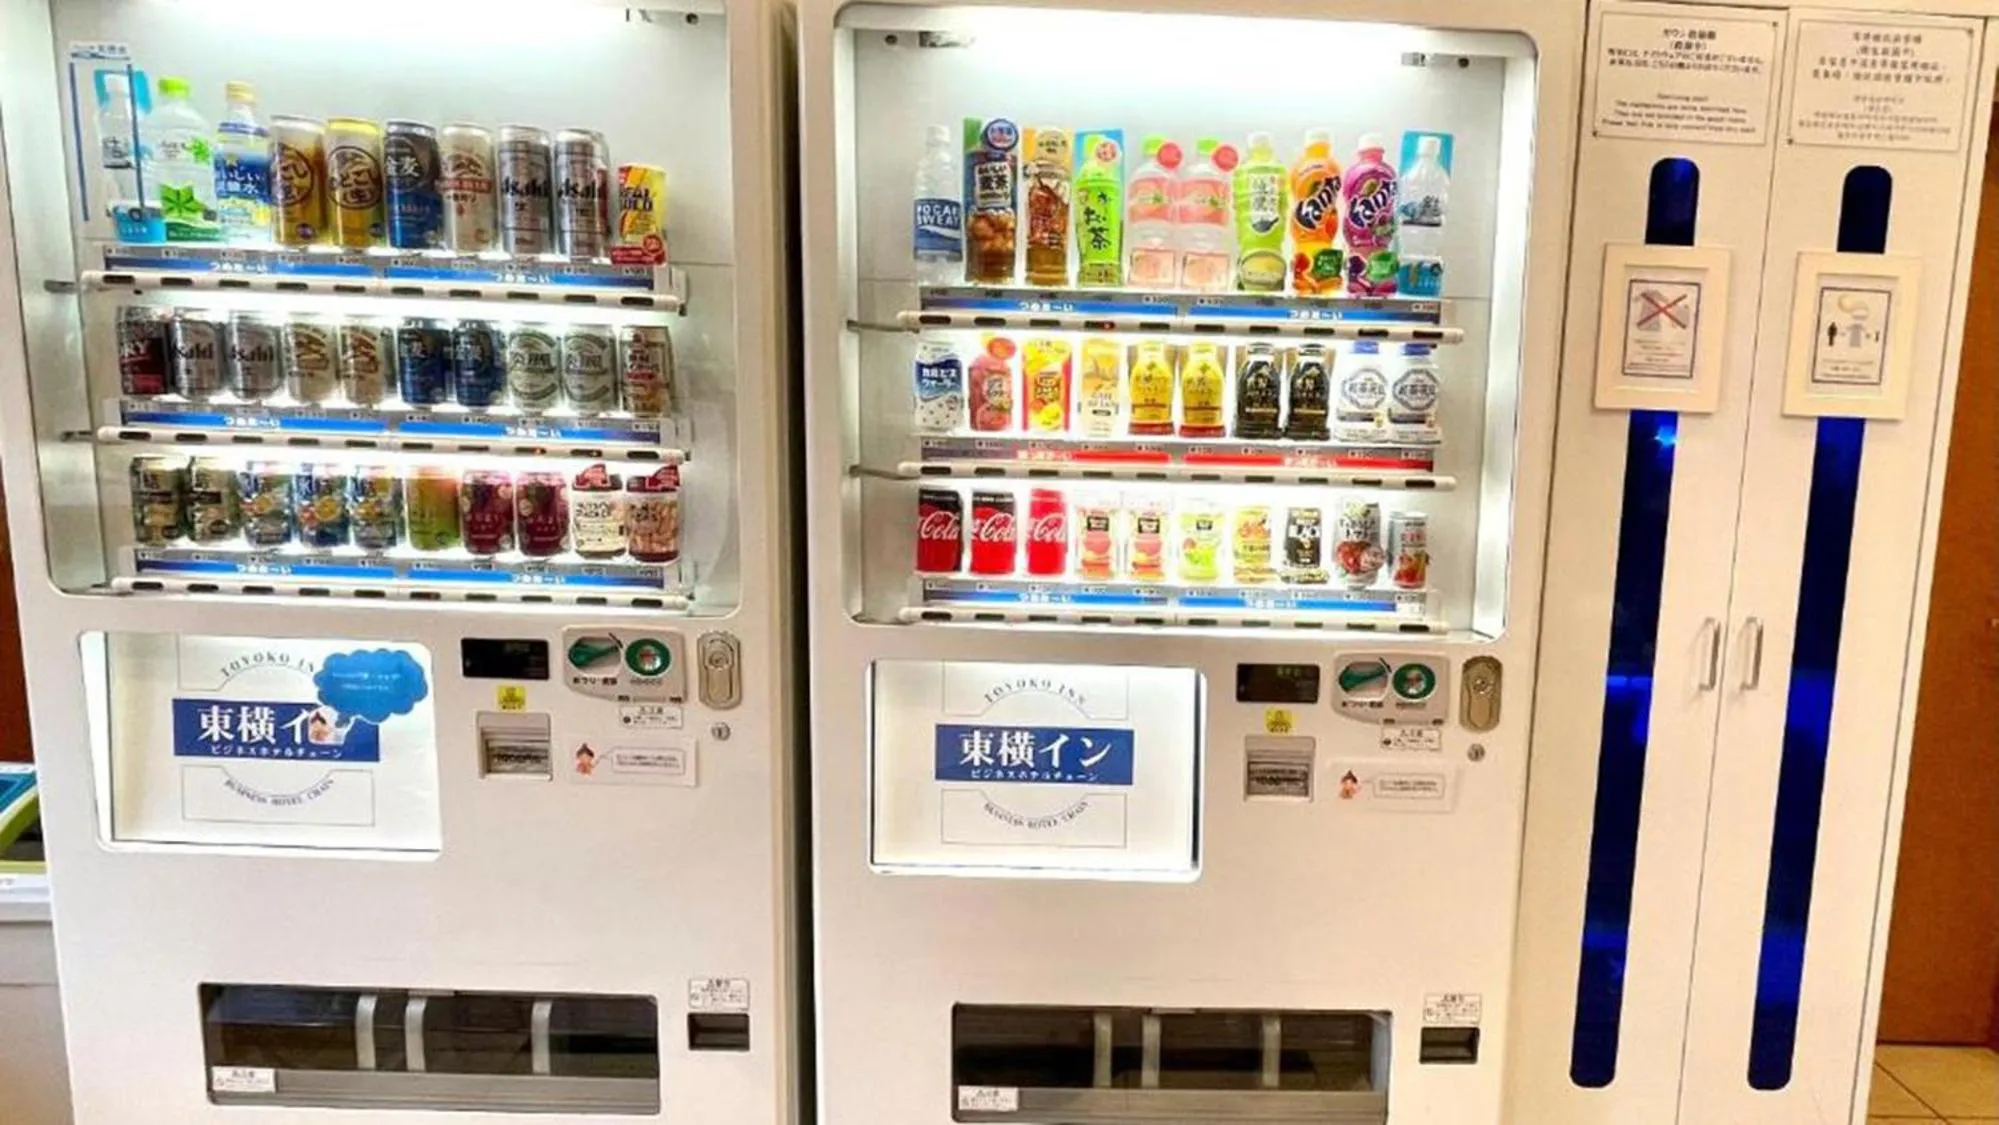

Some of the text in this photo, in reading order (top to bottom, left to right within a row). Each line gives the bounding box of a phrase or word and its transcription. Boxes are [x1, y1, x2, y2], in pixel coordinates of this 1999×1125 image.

[1295, 176, 1342, 230] Fanta
[1350, 181, 1398, 228] Fanta
[220, 651, 292, 677] TOYOKO
[984, 678, 1053, 704] TOYOKO
[959, 729, 1113, 769] 東横イン
[970, 768, 1099, 783] ビジネスホテルチェーン
